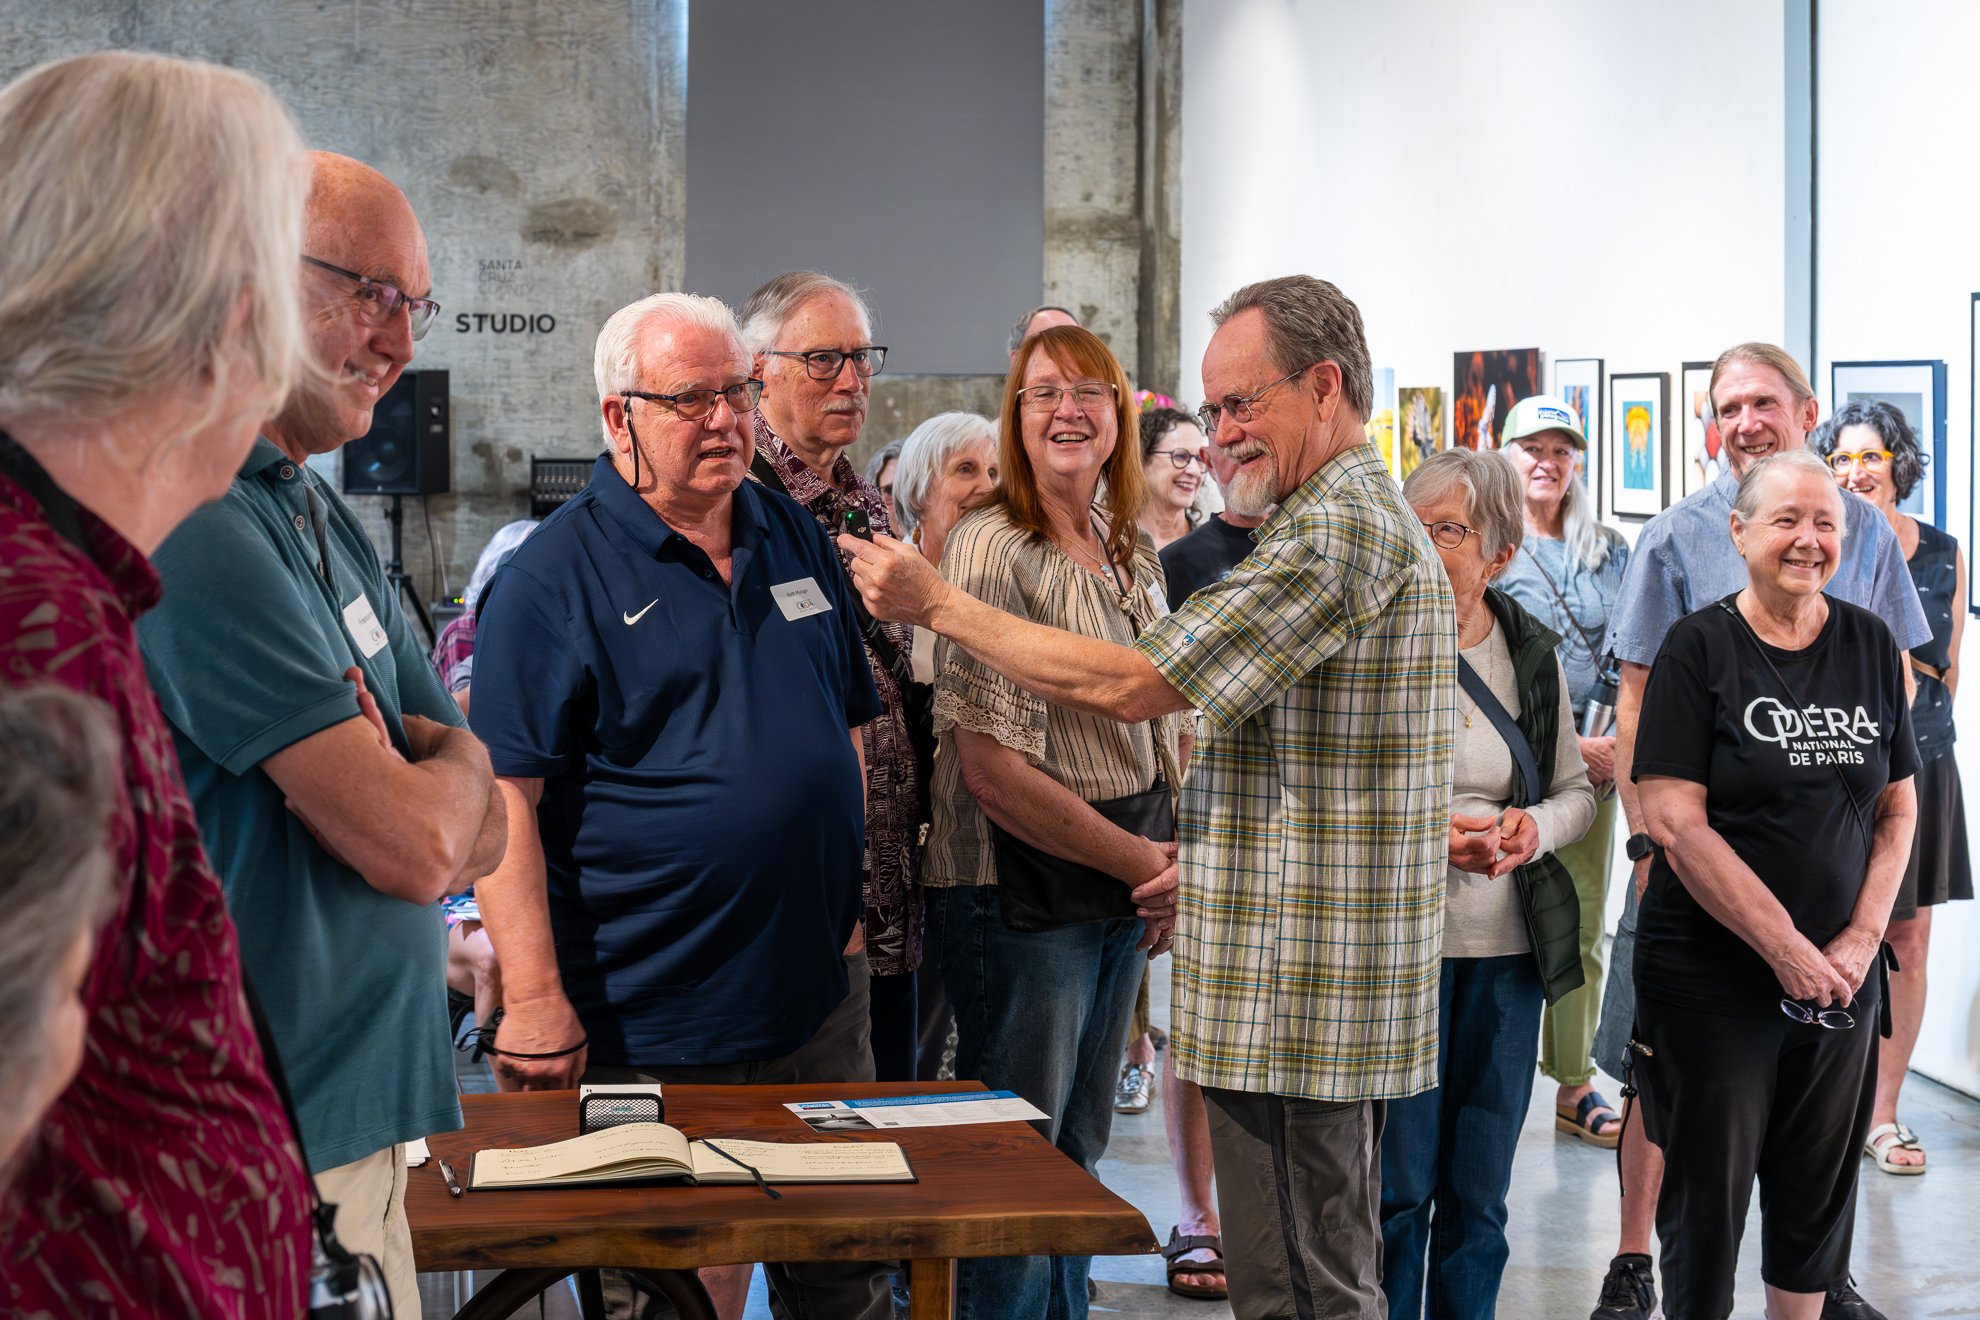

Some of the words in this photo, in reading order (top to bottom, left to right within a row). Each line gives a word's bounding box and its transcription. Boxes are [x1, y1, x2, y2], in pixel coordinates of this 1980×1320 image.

[478, 259, 523, 271] SANTA
[478, 272, 516, 283] CRUZ
[456, 313, 556, 334] STUDIO
[1744, 696, 1880, 749] OPÉRA
[1792, 740, 1855, 751] NATIONAL
[1789, 752, 1811, 766] DE
[1816, 751, 1864, 765] PARIS
